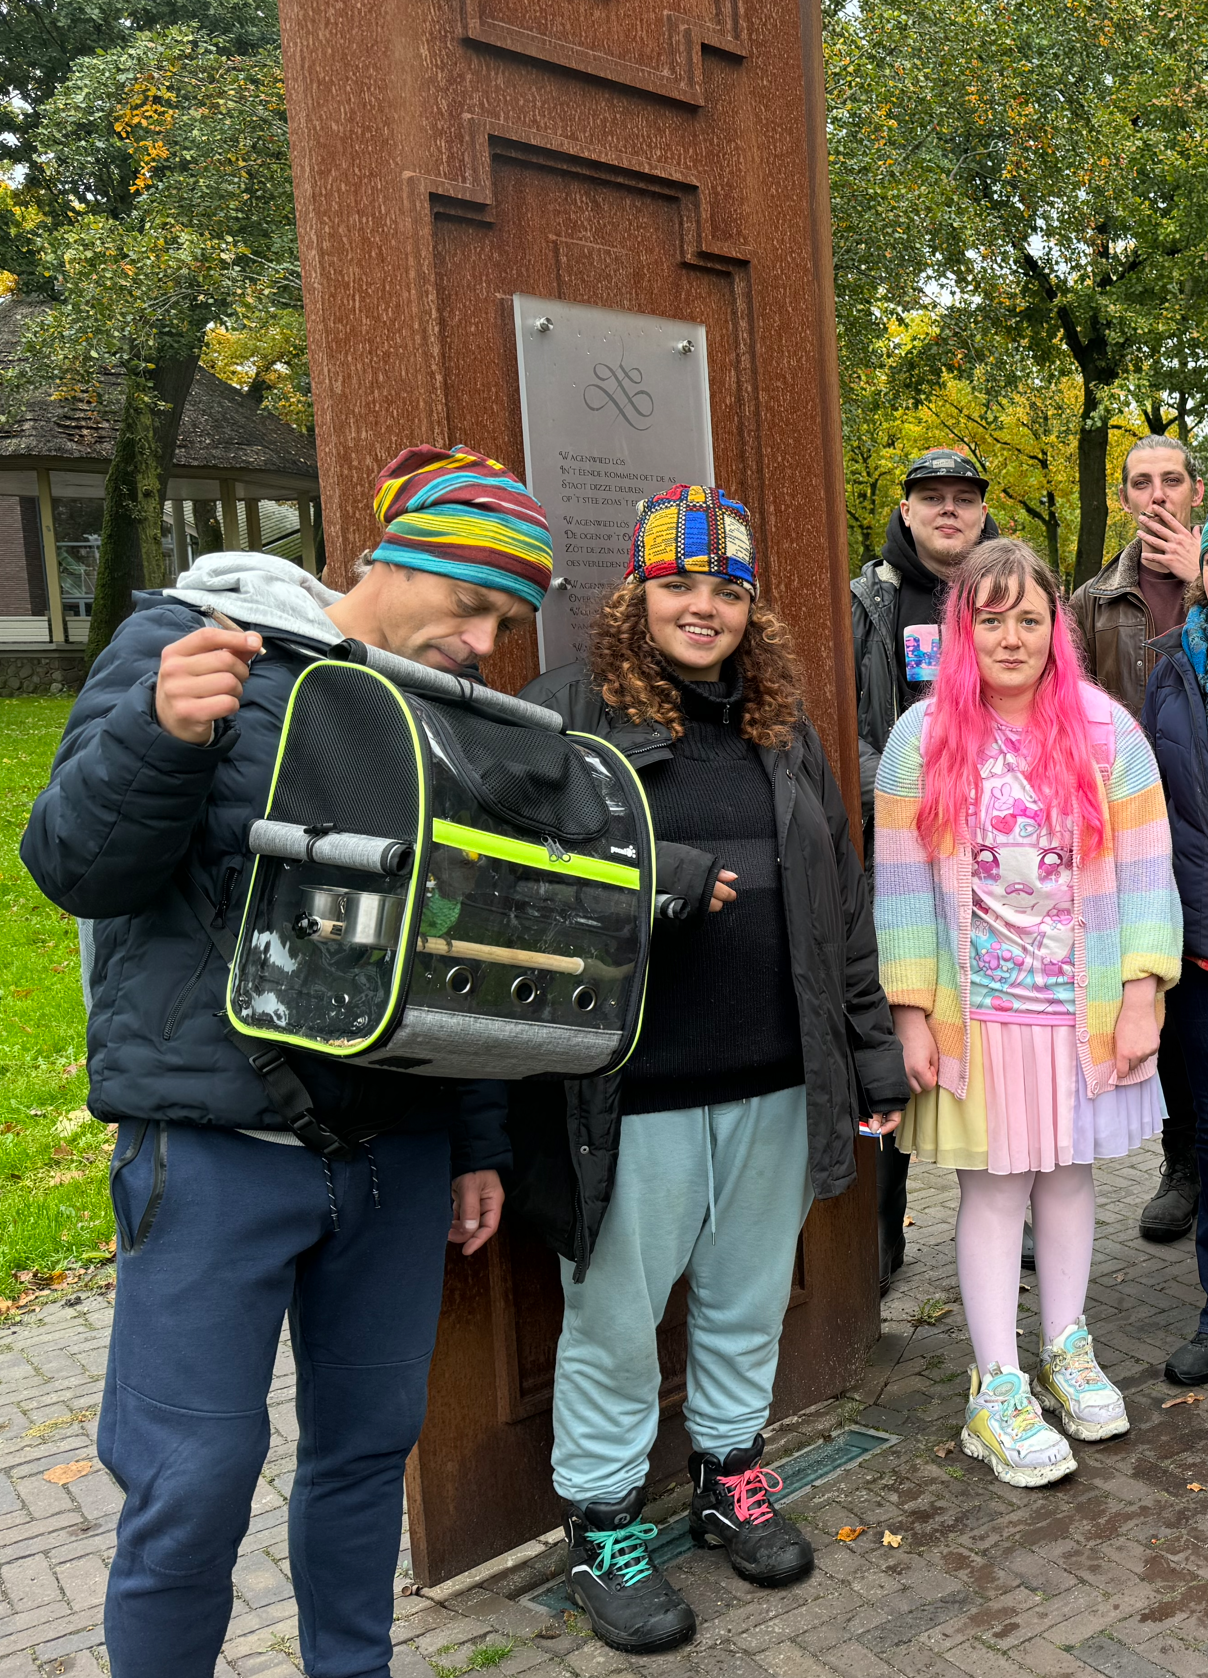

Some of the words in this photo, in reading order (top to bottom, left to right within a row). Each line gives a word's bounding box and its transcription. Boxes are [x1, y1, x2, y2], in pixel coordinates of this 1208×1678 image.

[604, 471, 638, 481] KOMMEN
[640, 474, 654, 482] OET
[656, 475, 666, 483] DE
[668, 476, 677, 484] AS
[561, 479, 587, 490] STAOT
[589, 483, 612, 492] DIZZE
[614, 485, 644, 494] DEUREN
[561, 495, 572, 503] OP
[582, 496, 600, 505] STEE
[601, 498, 622, 506] ZOAS
[563, 515, 615, 528] WAGENWIED
[564, 529, 578, 540] DE
[579, 532, 601, 541] OGEN
[602, 533, 612, 541] OP
[586, 546, 597, 554] DE
[598, 547, 614, 555] ZUN
[566, 559, 580, 567] OES
[581, 560, 621, 568] VERLEDEN
